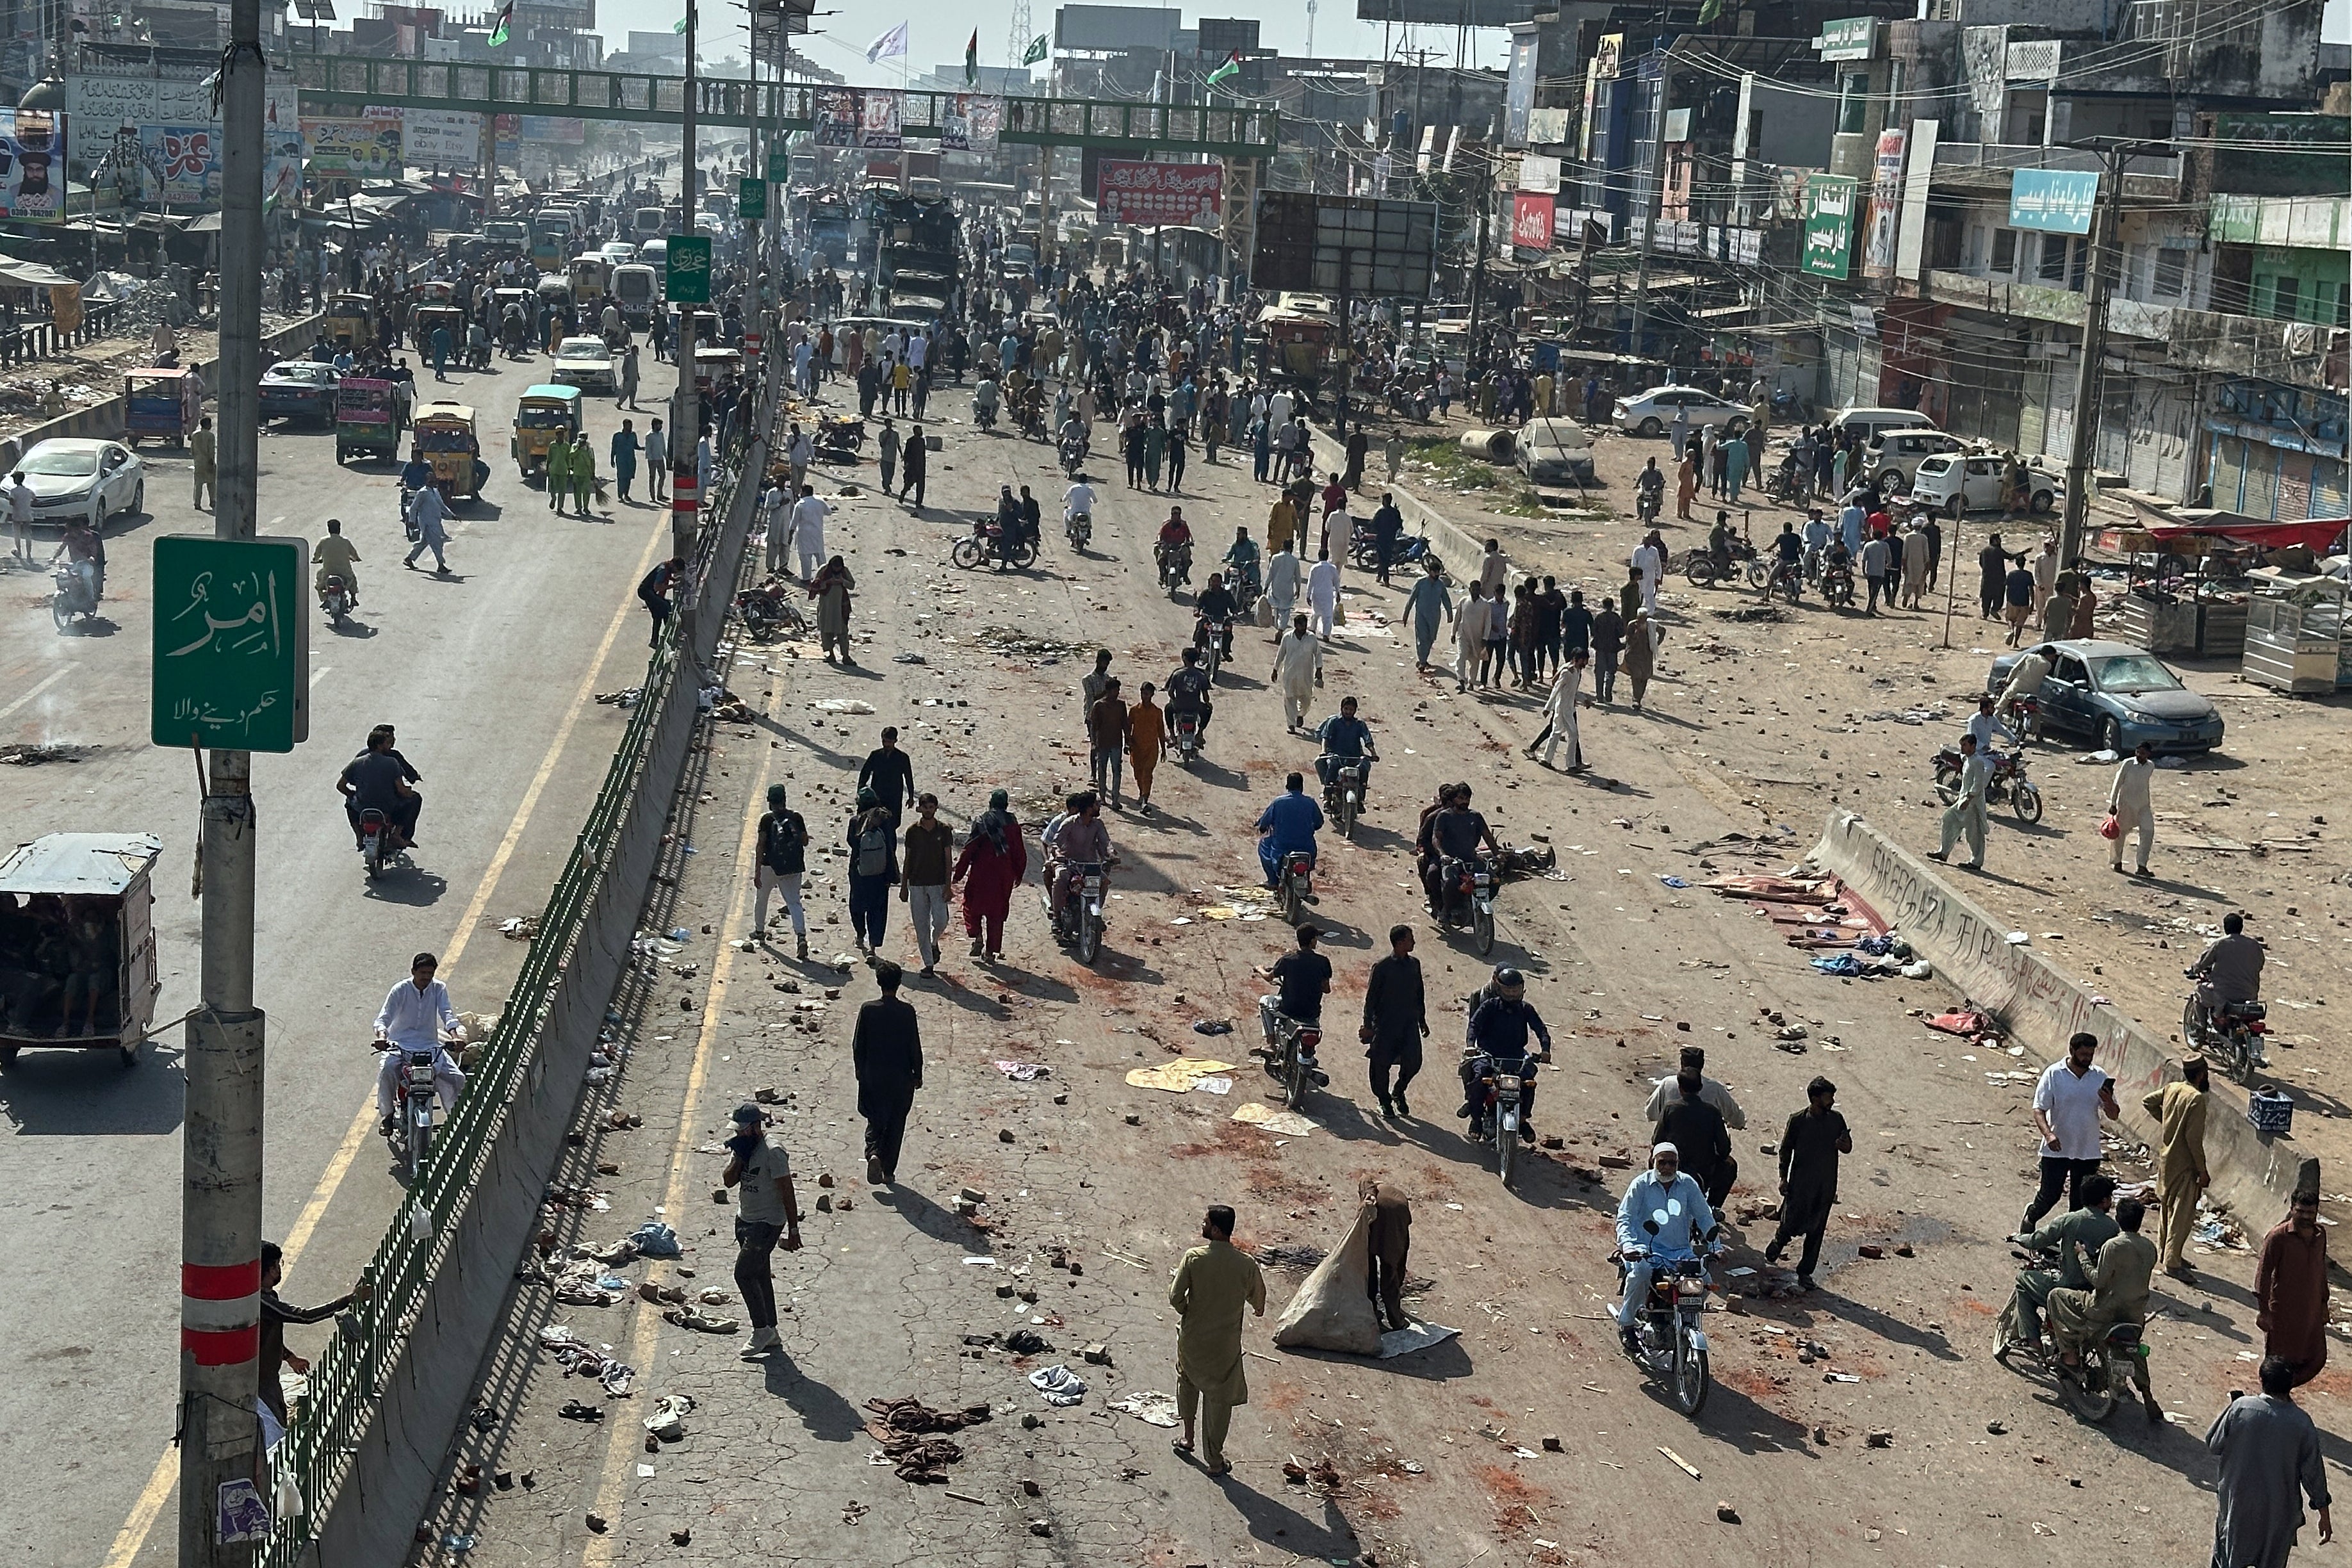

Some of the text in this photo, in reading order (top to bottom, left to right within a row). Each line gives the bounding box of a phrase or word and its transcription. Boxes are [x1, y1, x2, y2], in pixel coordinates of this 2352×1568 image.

[413, 126, 440, 135] amazon
[445, 140, 464, 152] Etsy
[165, 133, 212, 181] عمرہ
[1811, 183, 1850, 220] افتخار
[1808, 220, 1846, 256] فارمیسی
[173, 690, 280, 737] حکم دینے والا
